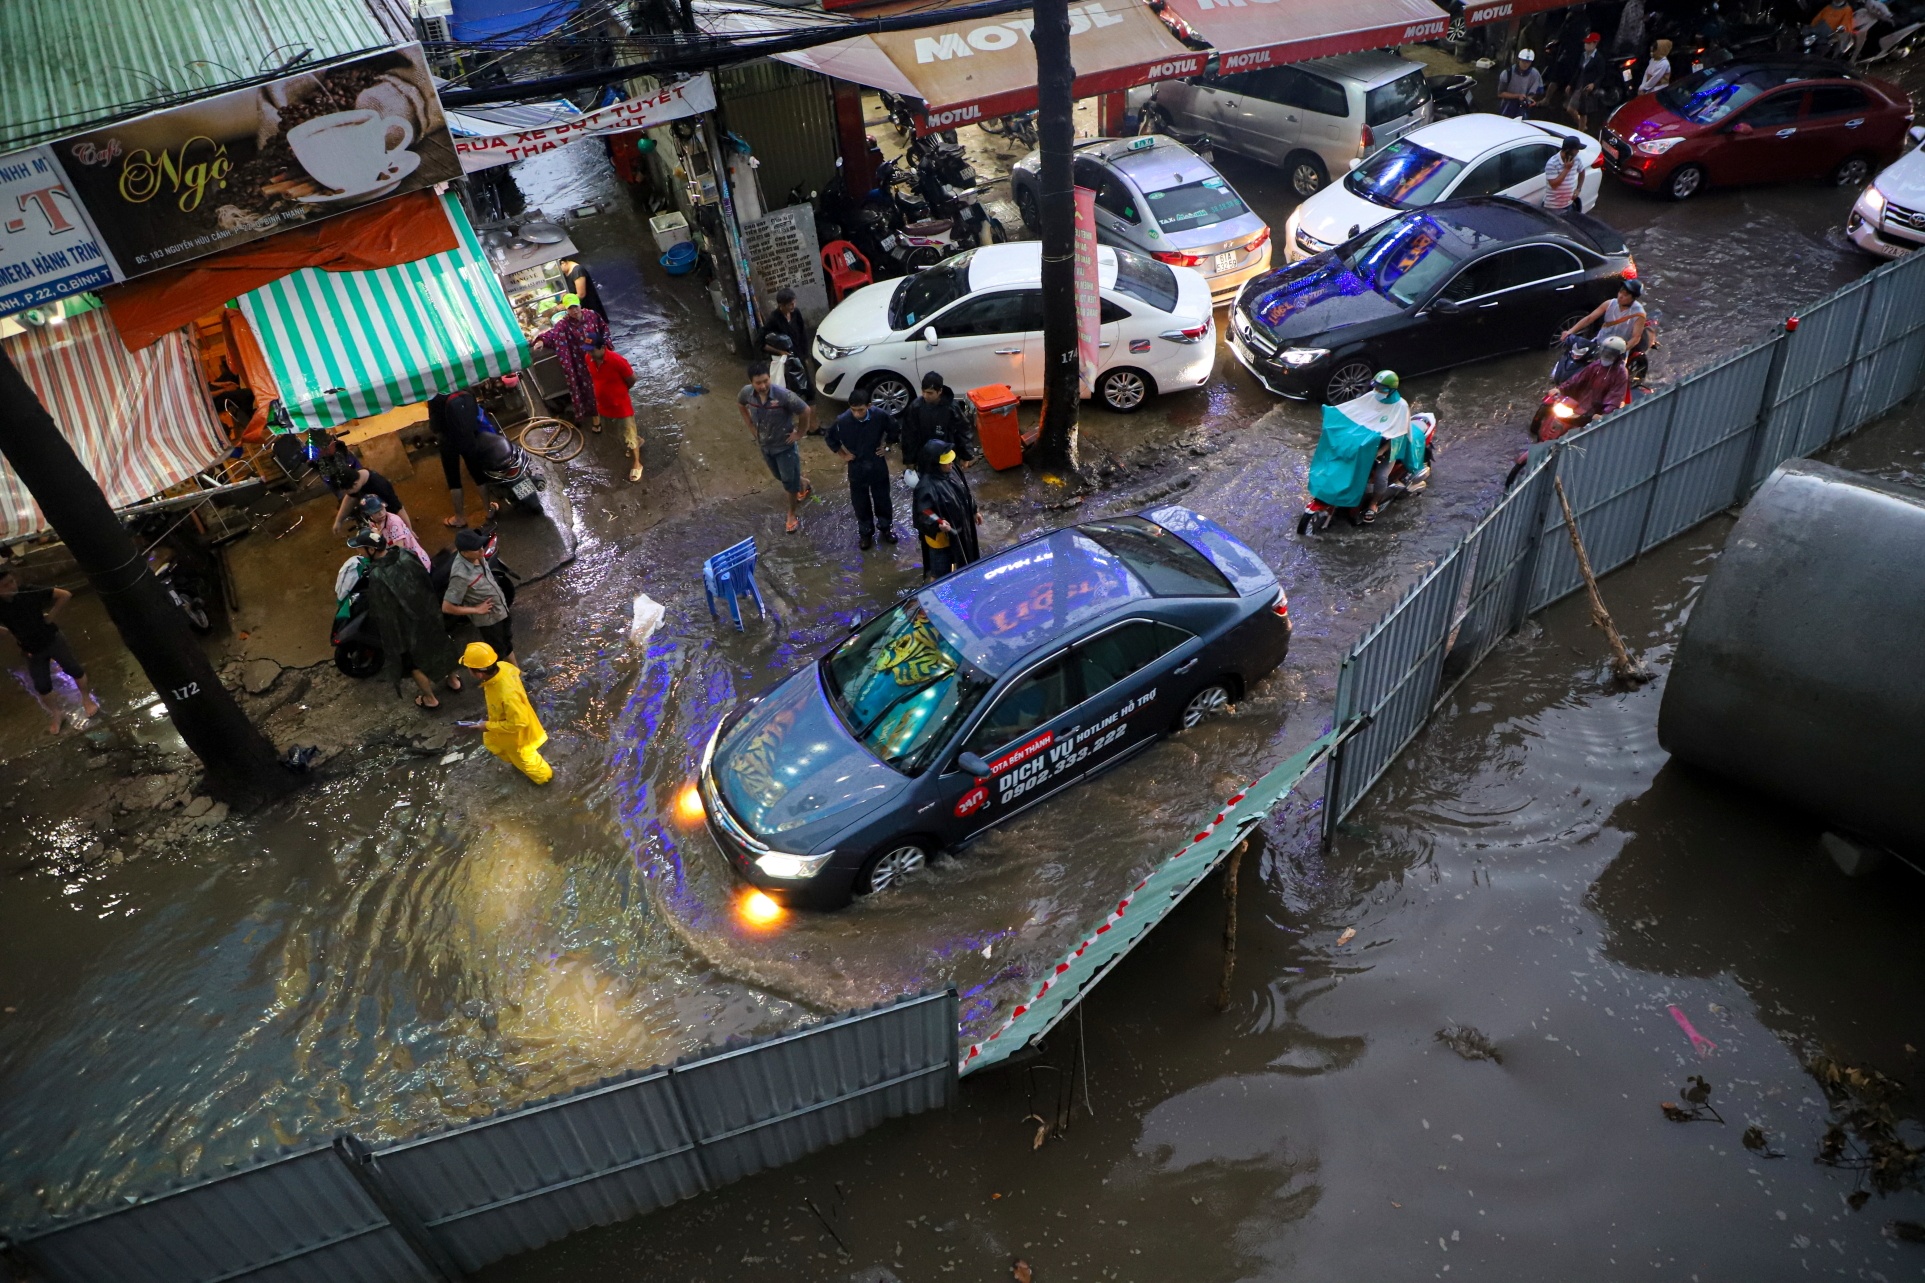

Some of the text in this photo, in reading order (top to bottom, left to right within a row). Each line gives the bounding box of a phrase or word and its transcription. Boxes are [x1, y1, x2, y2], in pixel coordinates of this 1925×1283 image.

[1471, 3, 1513, 22] MOTUL
[1404, 21, 1445, 39] MOTUL
[1148, 58, 1197, 78] MOTUL
[1226, 50, 1271, 68] MOTUL
[927, 105, 981, 128] MOTUL
[0, 162, 31, 184] NHH
[119, 135, 234, 213] Ngộ
[32, 252, 71, 276] HÀNH
[150, 249, 164, 260] 183
[171, 681, 200, 700] 172
[1076, 711, 1119, 743] HOTLINE
[1137, 688, 1157, 707] TRỢ
[1009, 751, 1024, 765] BẾN
[1025, 736, 1051, 756] THÀNH
[999, 737, 1074, 792] DỊCH VỤ
[1001, 722, 1127, 804] 0902.333.222
